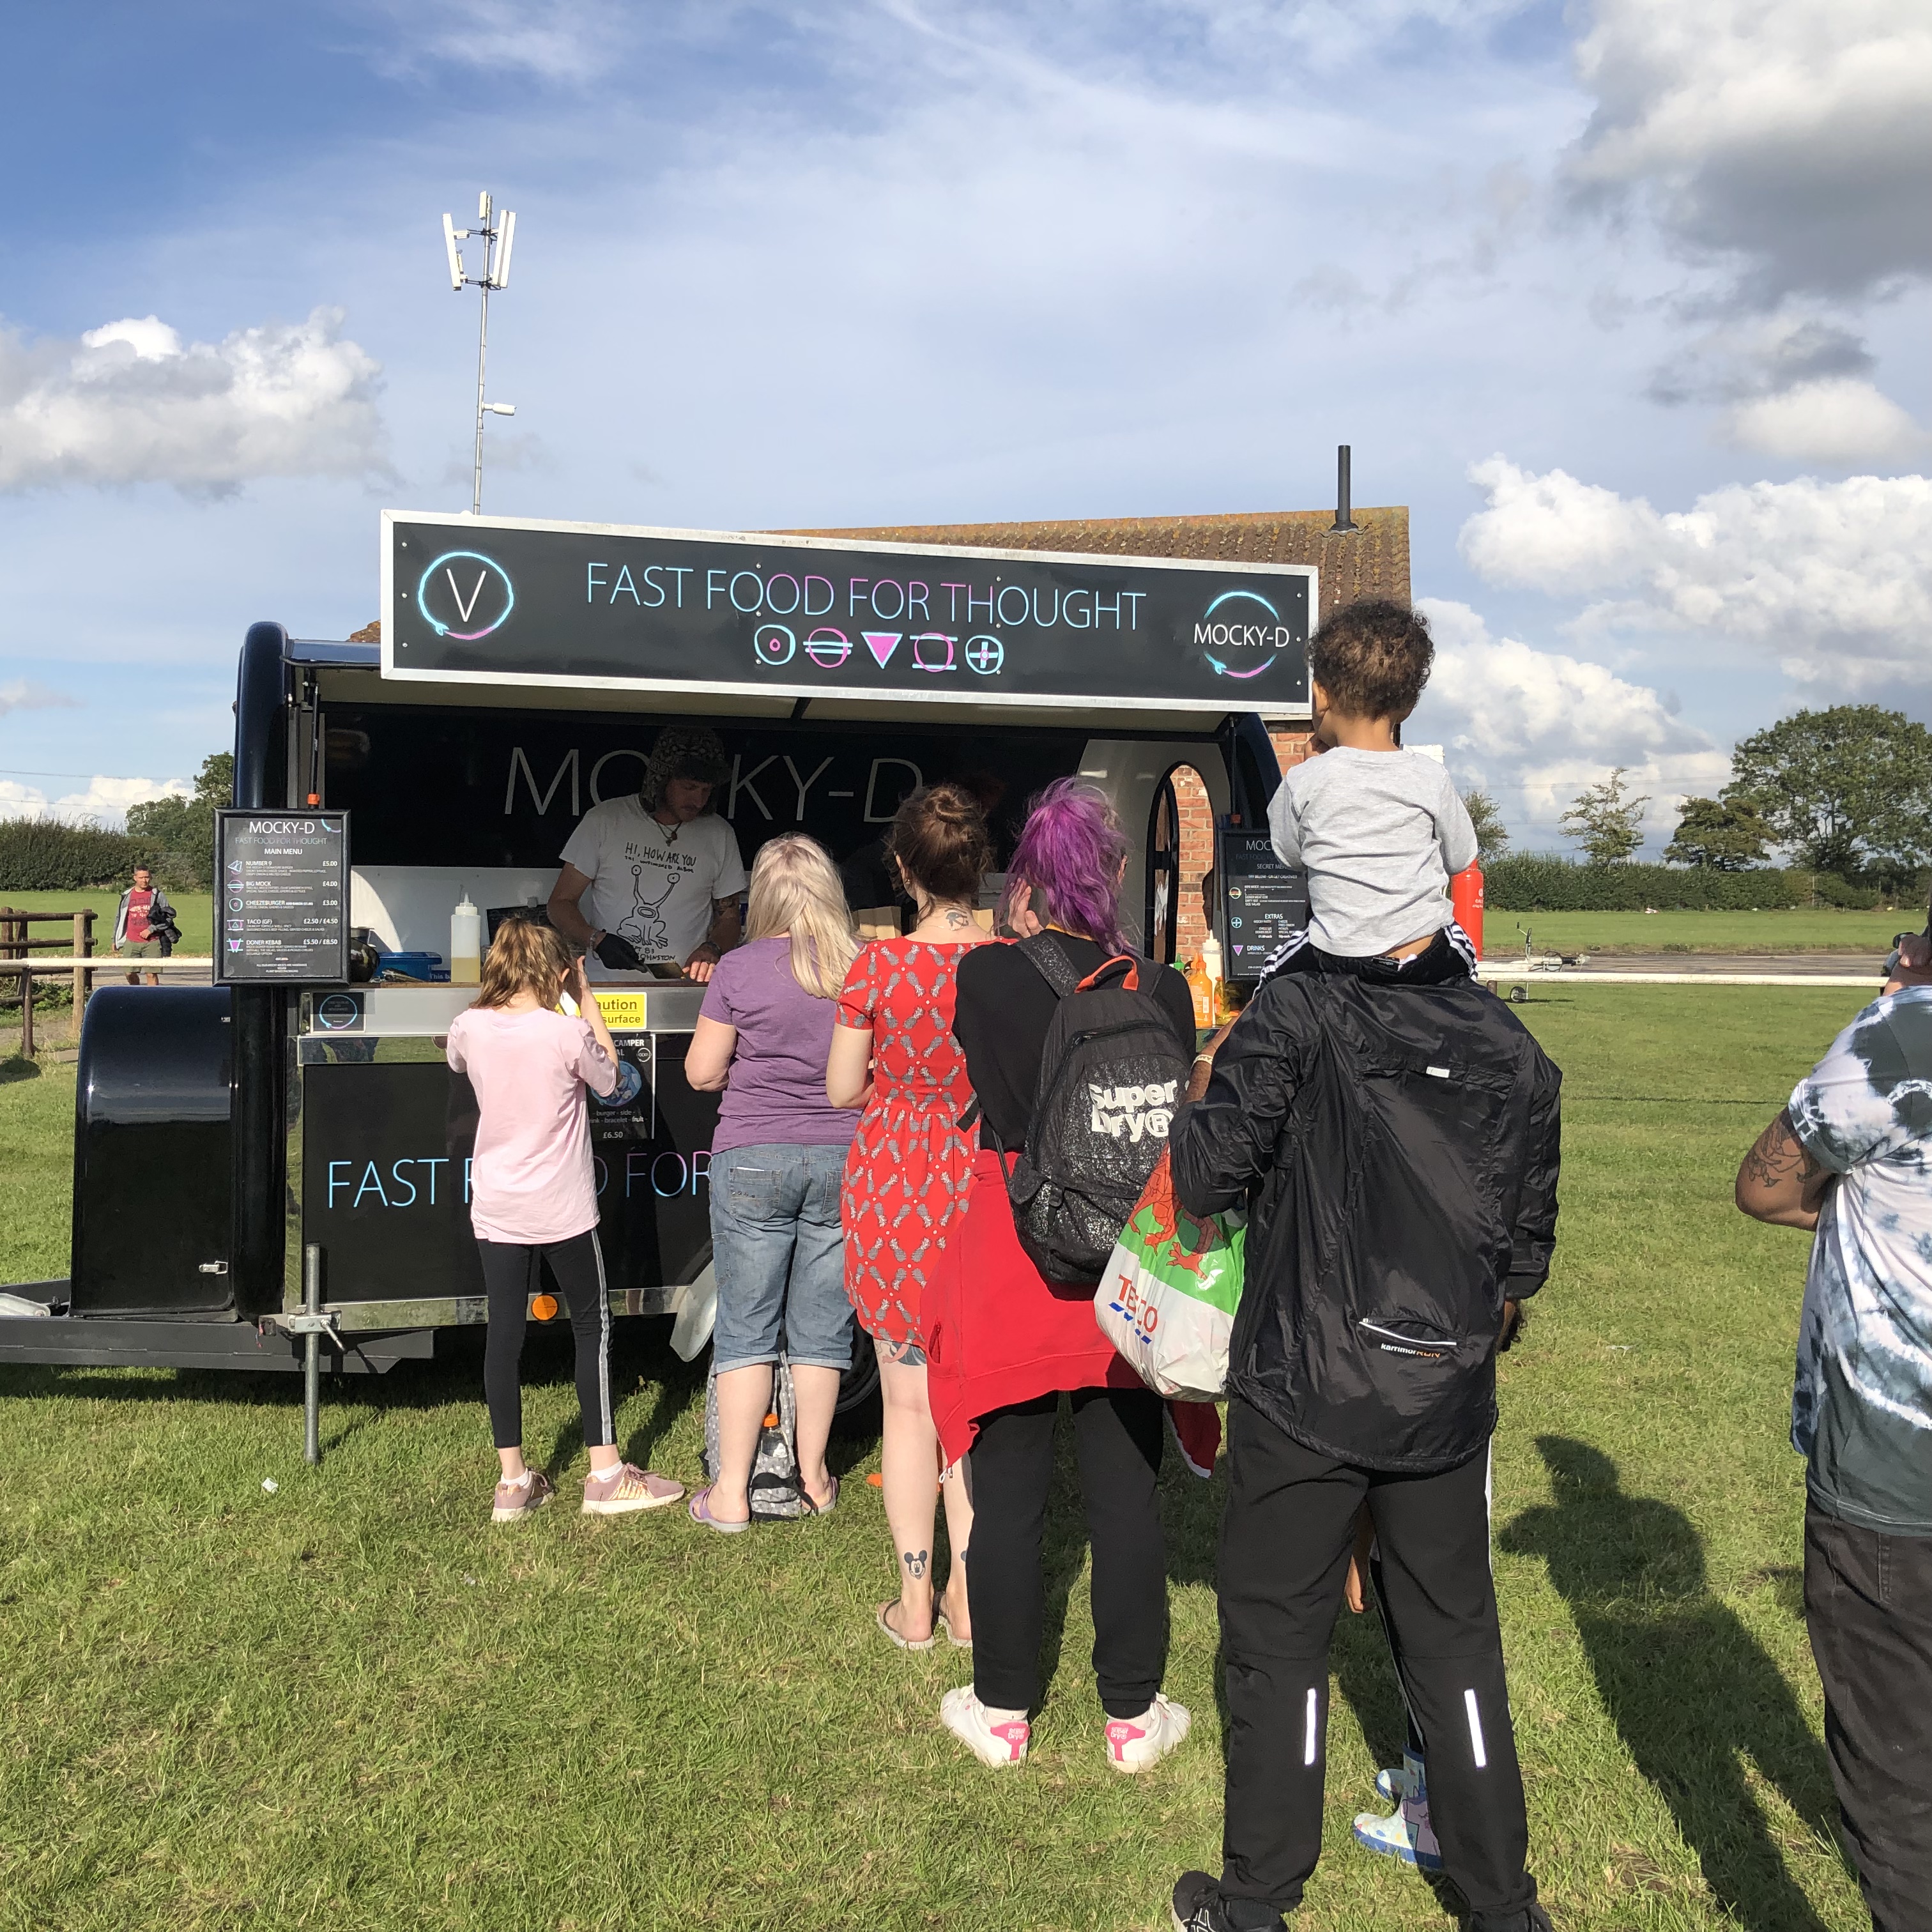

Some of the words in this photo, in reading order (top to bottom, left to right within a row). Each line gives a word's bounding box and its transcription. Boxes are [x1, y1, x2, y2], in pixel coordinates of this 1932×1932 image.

[447, 568, 487, 622] V
[587, 562, 694, 608] FAST
[707, 569, 834, 617] FOOD
[849, 578, 930, 622] FOR
[940, 582, 1147, 631] THOUGHT
[1193, 623, 1291, 648] MOCKY-D
[504, 746, 923, 824] MOKY-D
[249, 821, 315, 834] MOCKY-D
[643, 846, 666, 861] HOW
[666, 852, 680, 864] ARE
[682, 854, 697, 866] YOU
[638, 952, 676, 961] OHNSTON
[597, 999, 637, 1010] aution
[614, 1038, 645, 1047] CAMPER
[1088, 1079, 1178, 1113] Super
[328, 1157, 450, 1208] FAST
[626, 1151, 714, 1199] FOR
